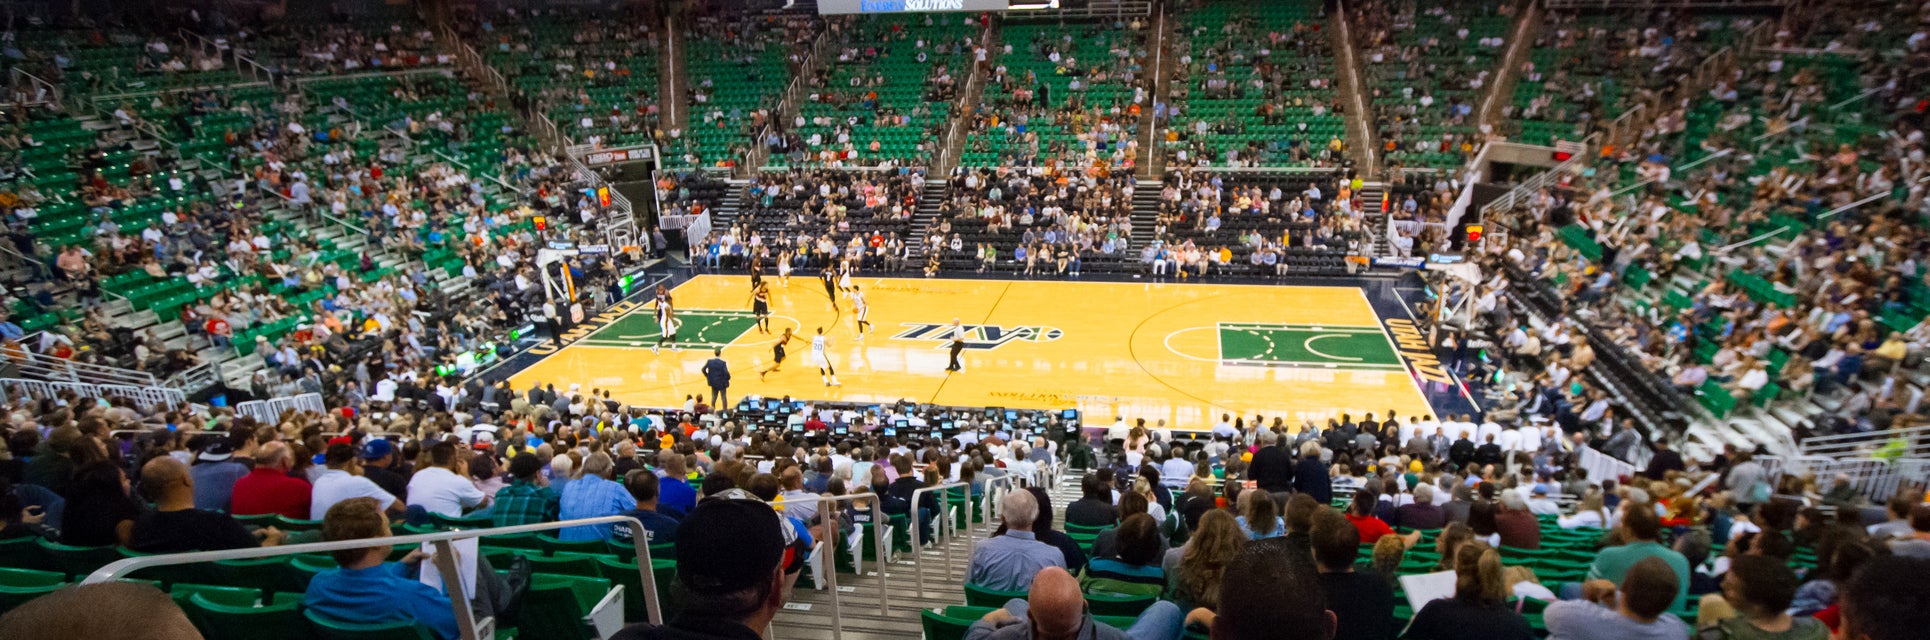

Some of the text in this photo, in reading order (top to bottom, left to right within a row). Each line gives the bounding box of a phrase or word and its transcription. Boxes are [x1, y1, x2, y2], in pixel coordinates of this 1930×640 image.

[813, 342, 823, 351] 20
[1385, 318, 1430, 350] UTAH
[1399, 350, 1455, 385] JAZZ
